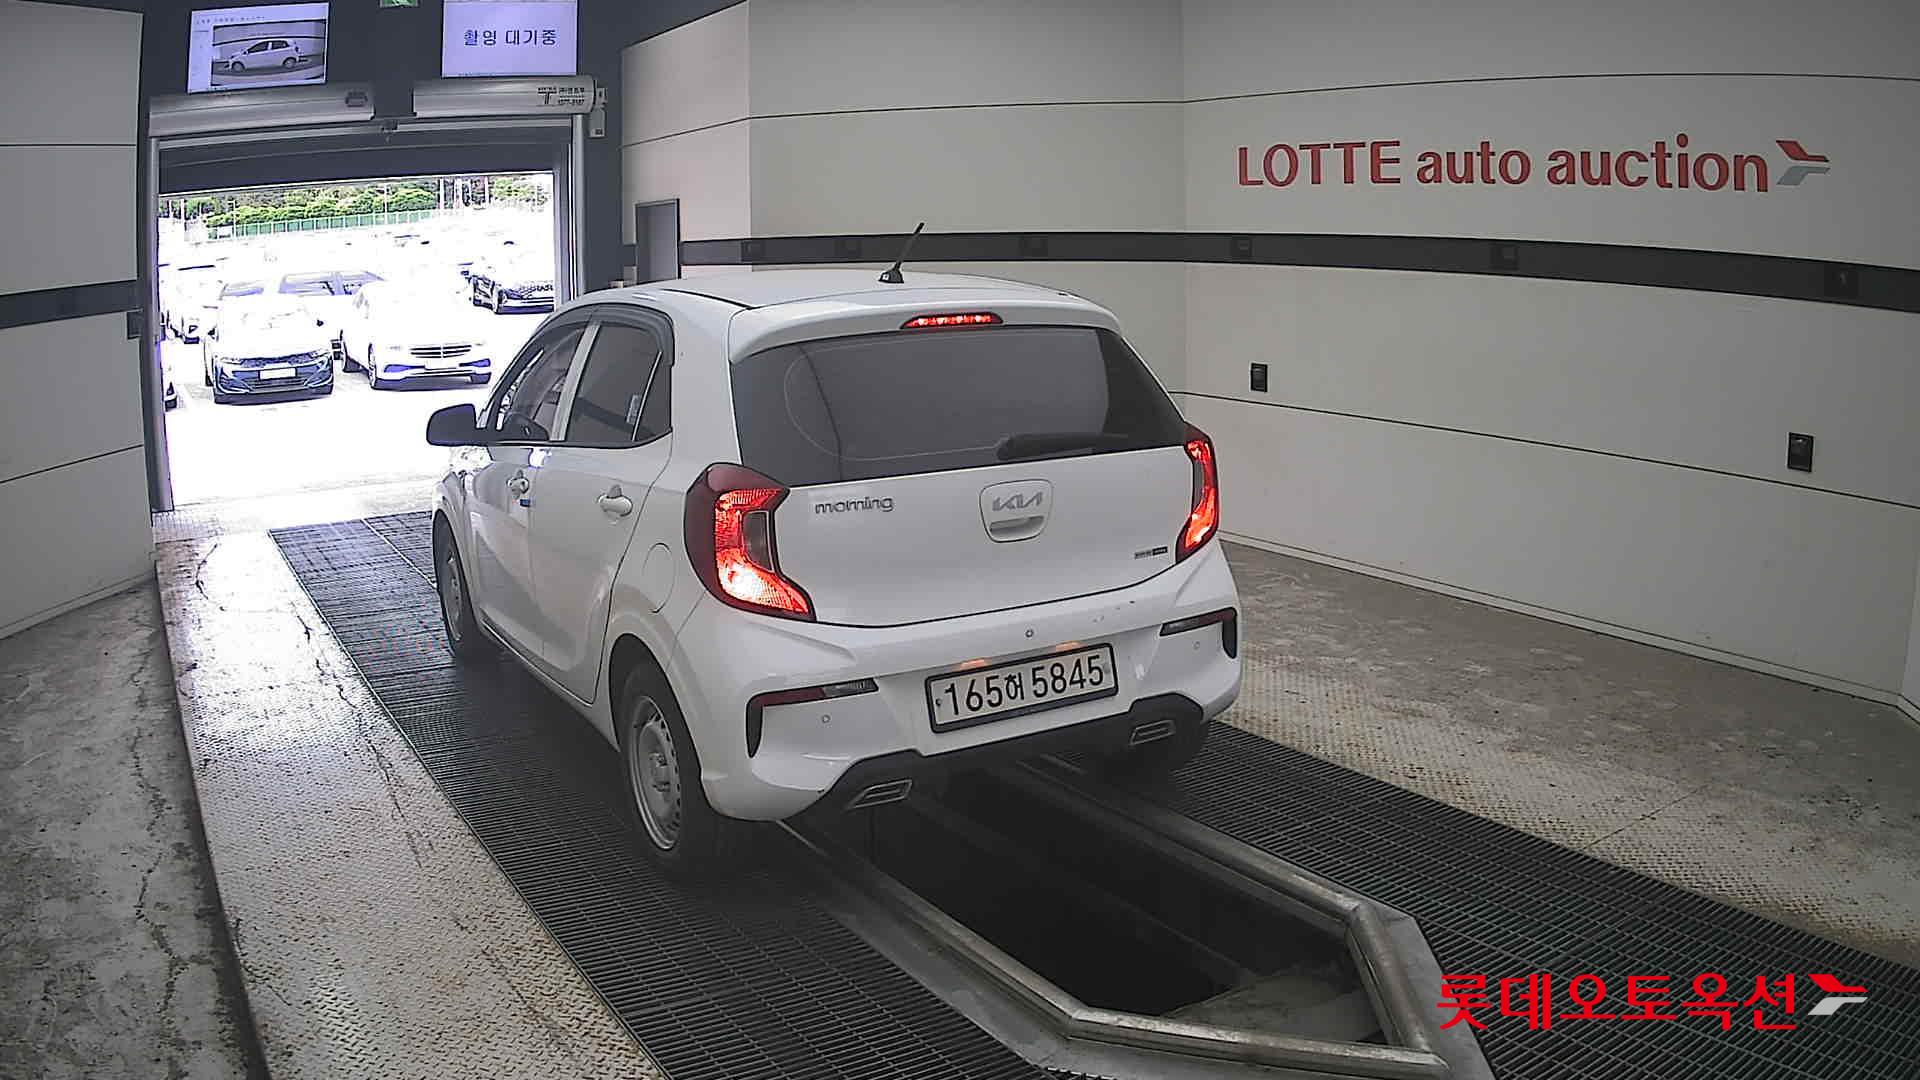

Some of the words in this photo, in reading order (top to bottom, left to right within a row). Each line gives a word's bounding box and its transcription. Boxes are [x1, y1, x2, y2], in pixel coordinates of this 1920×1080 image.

[504, 28, 558, 46] 대기중
[1238, 140, 1400, 188] LOTTE
[1417, 143, 1532, 185] auto
[1547, 133, 1769, 193] auction
[814, 495, 895, 514] morning
[944, 671, 1025, 716] 165허
[1031, 654, 1104, 698] 5845
